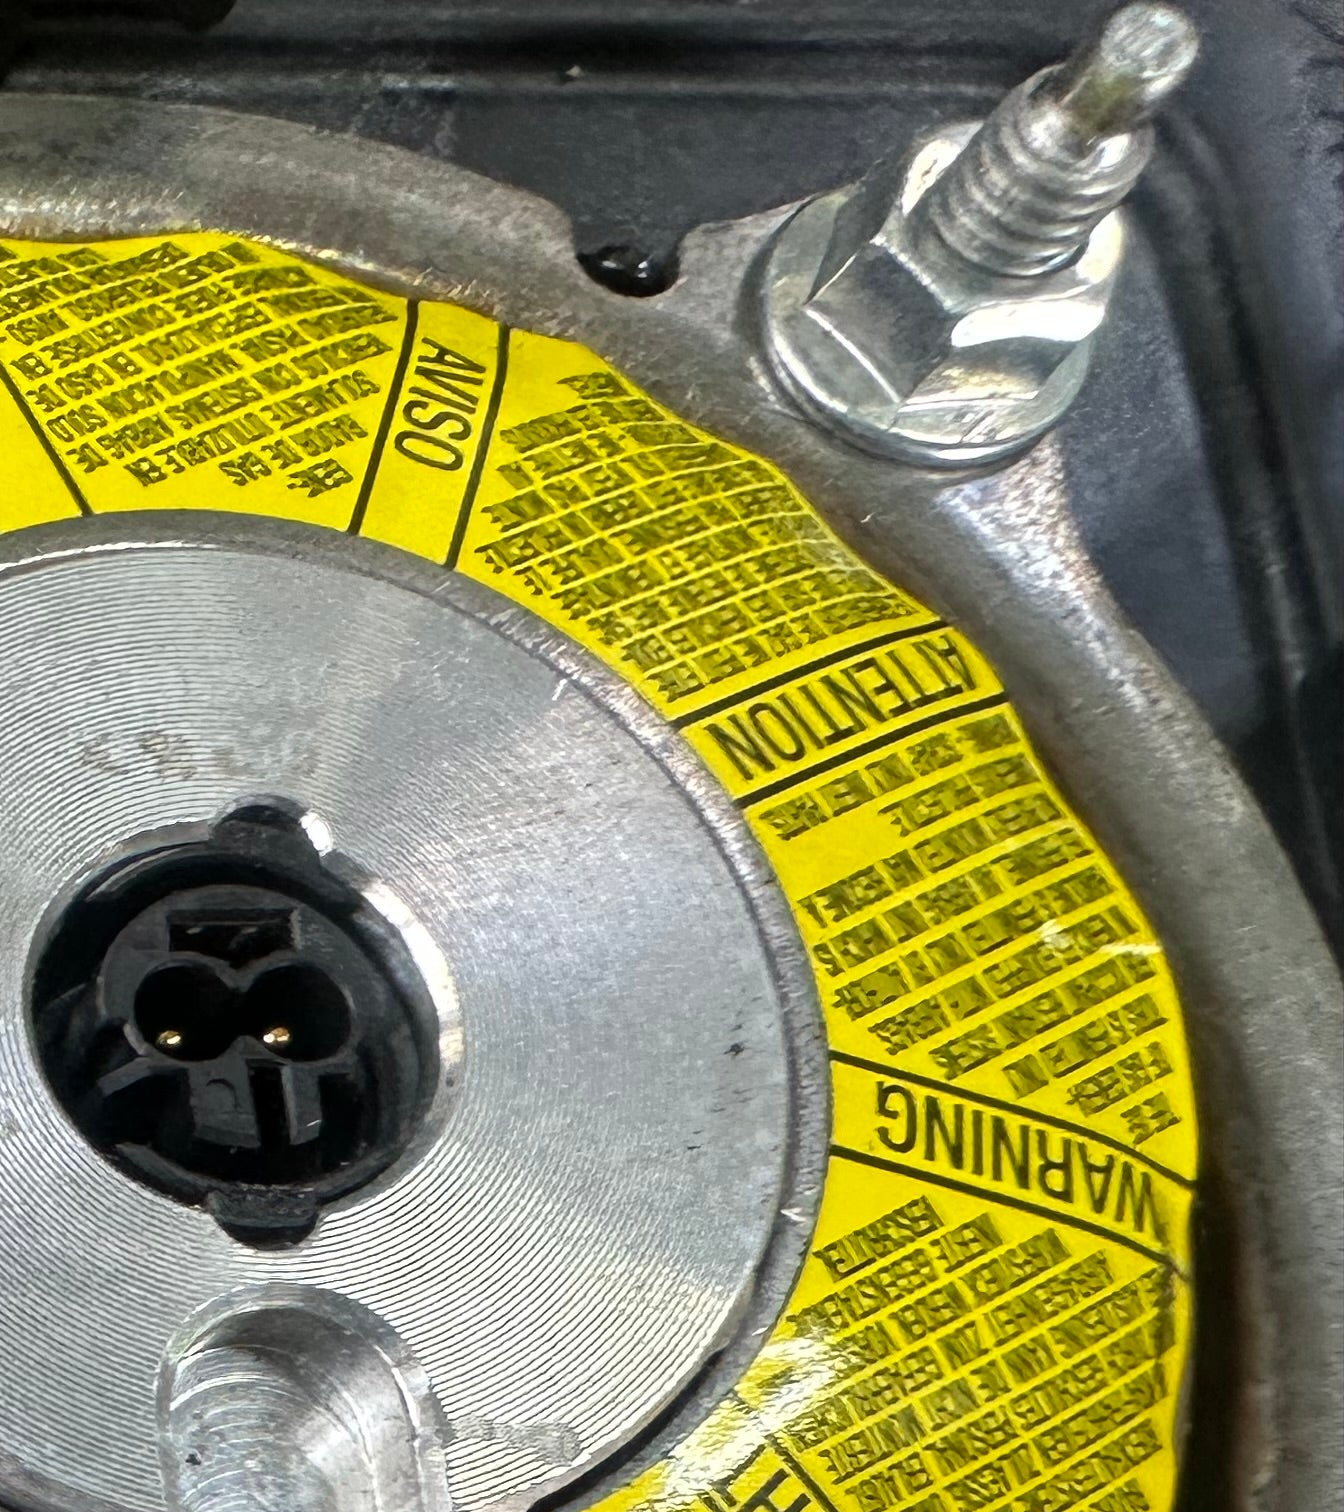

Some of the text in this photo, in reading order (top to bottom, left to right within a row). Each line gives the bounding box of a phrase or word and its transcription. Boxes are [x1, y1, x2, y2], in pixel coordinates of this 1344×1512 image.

[393, 336, 486, 473] AVISO
[707, 633, 979, 782] ATTENTION
[874, 1080, 1162, 1234] WARNING
